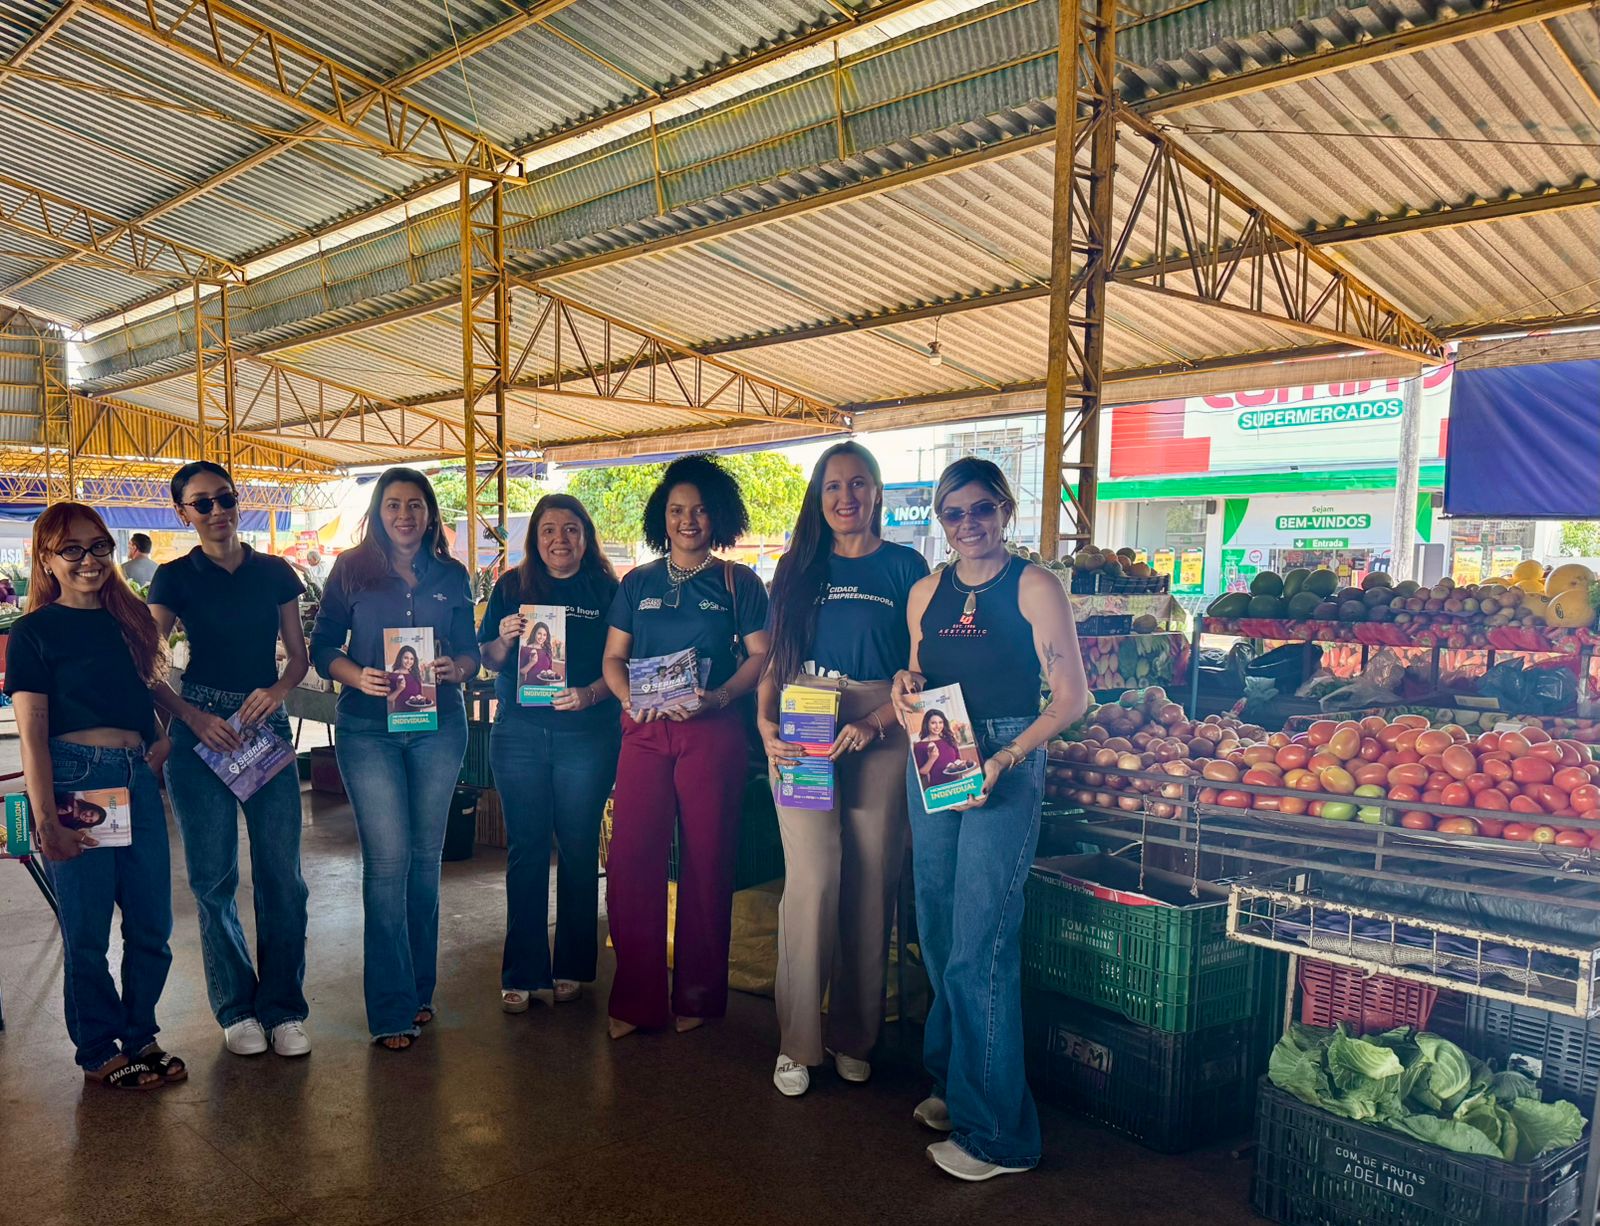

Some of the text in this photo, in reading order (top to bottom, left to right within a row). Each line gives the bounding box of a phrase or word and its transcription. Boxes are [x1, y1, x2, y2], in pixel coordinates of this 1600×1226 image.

[1241, 400, 1401, 429] SUPERMERCADOS
[1312, 505, 1334, 514] Sejam
[1279, 515, 1367, 529] BEM-VINDOS
[1312, 538, 1344, 548] Entrada
[828, 593, 894, 607] EMPREENDEDORA
[237, 736, 270, 766] SEBRAE
[930, 783, 977, 800] INDIVIDUAL
[1061, 917, 1115, 941] TOMATINS
[109, 1063, 150, 1083] ANACAPRI
[1344, 1163, 1414, 1197] ADELINO
[1382, 1162, 1425, 1185] FRUTAS
